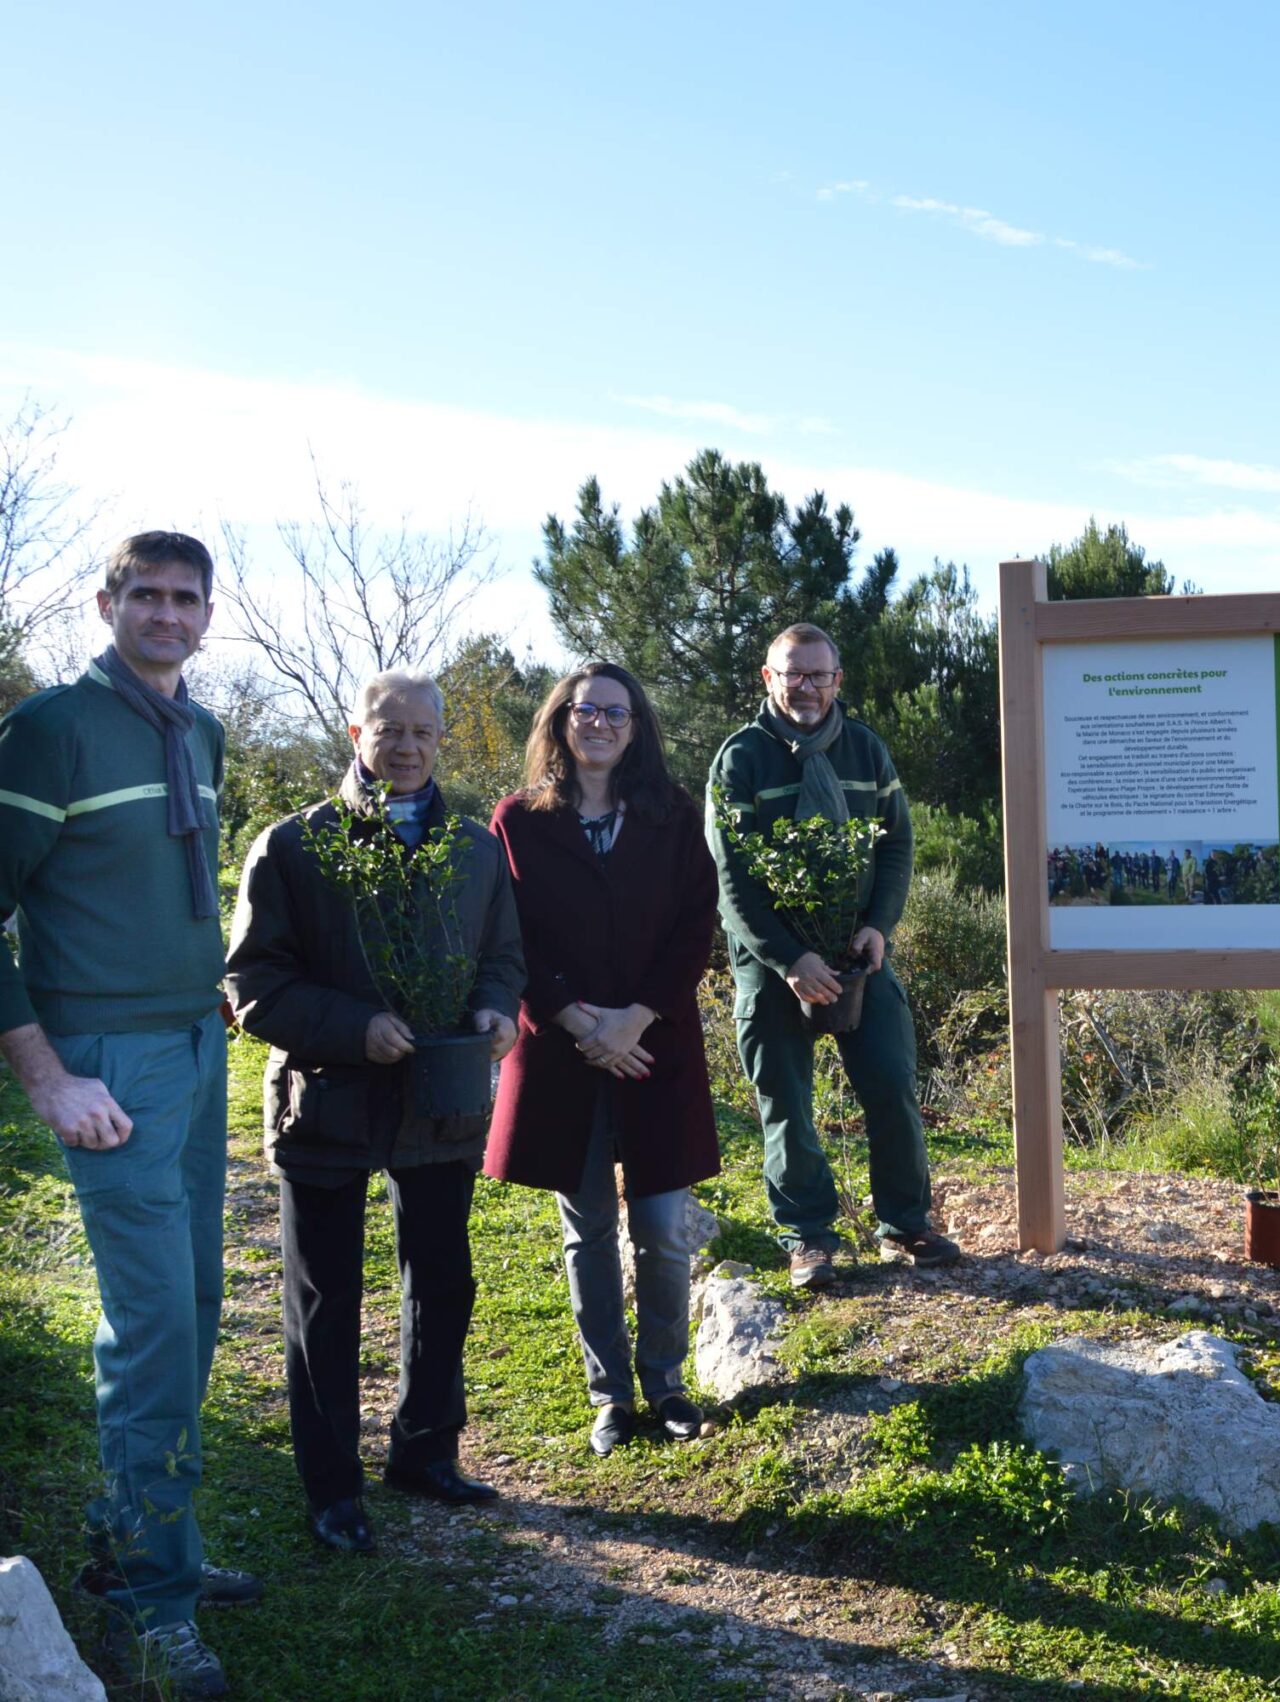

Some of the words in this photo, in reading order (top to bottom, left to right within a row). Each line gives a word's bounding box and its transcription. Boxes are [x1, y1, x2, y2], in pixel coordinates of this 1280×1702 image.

[1083, 674, 1102, 682] Des
[1104, 672, 1144, 681] actions
[1147, 668, 1198, 680] concrètes
[1201, 671, 1227, 679] pour
[1109, 685, 1202, 696] l'environnement
